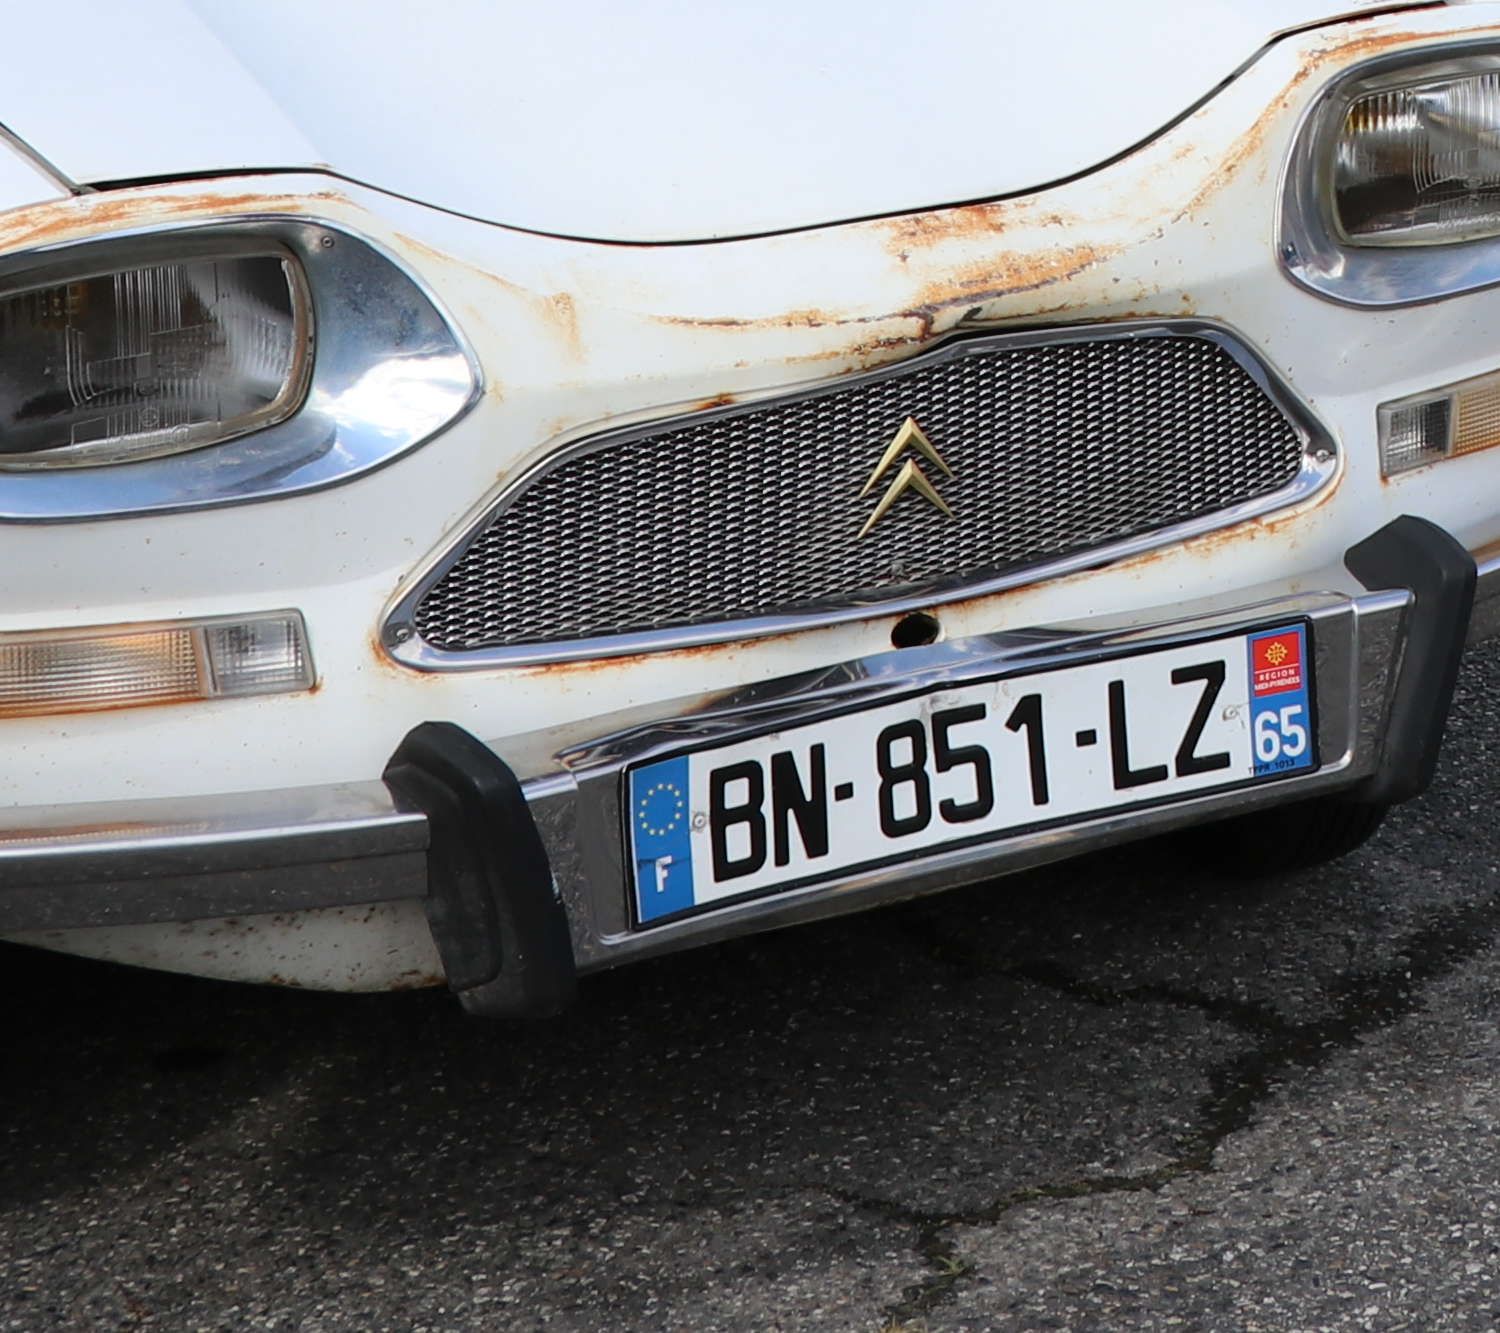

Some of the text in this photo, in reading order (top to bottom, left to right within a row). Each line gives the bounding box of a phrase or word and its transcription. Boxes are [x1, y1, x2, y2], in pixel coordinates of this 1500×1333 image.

[1254, 704, 1307, 763] 65
[710, 661, 1232, 883] BN-851-LZ
[655, 855, 673, 893] F
